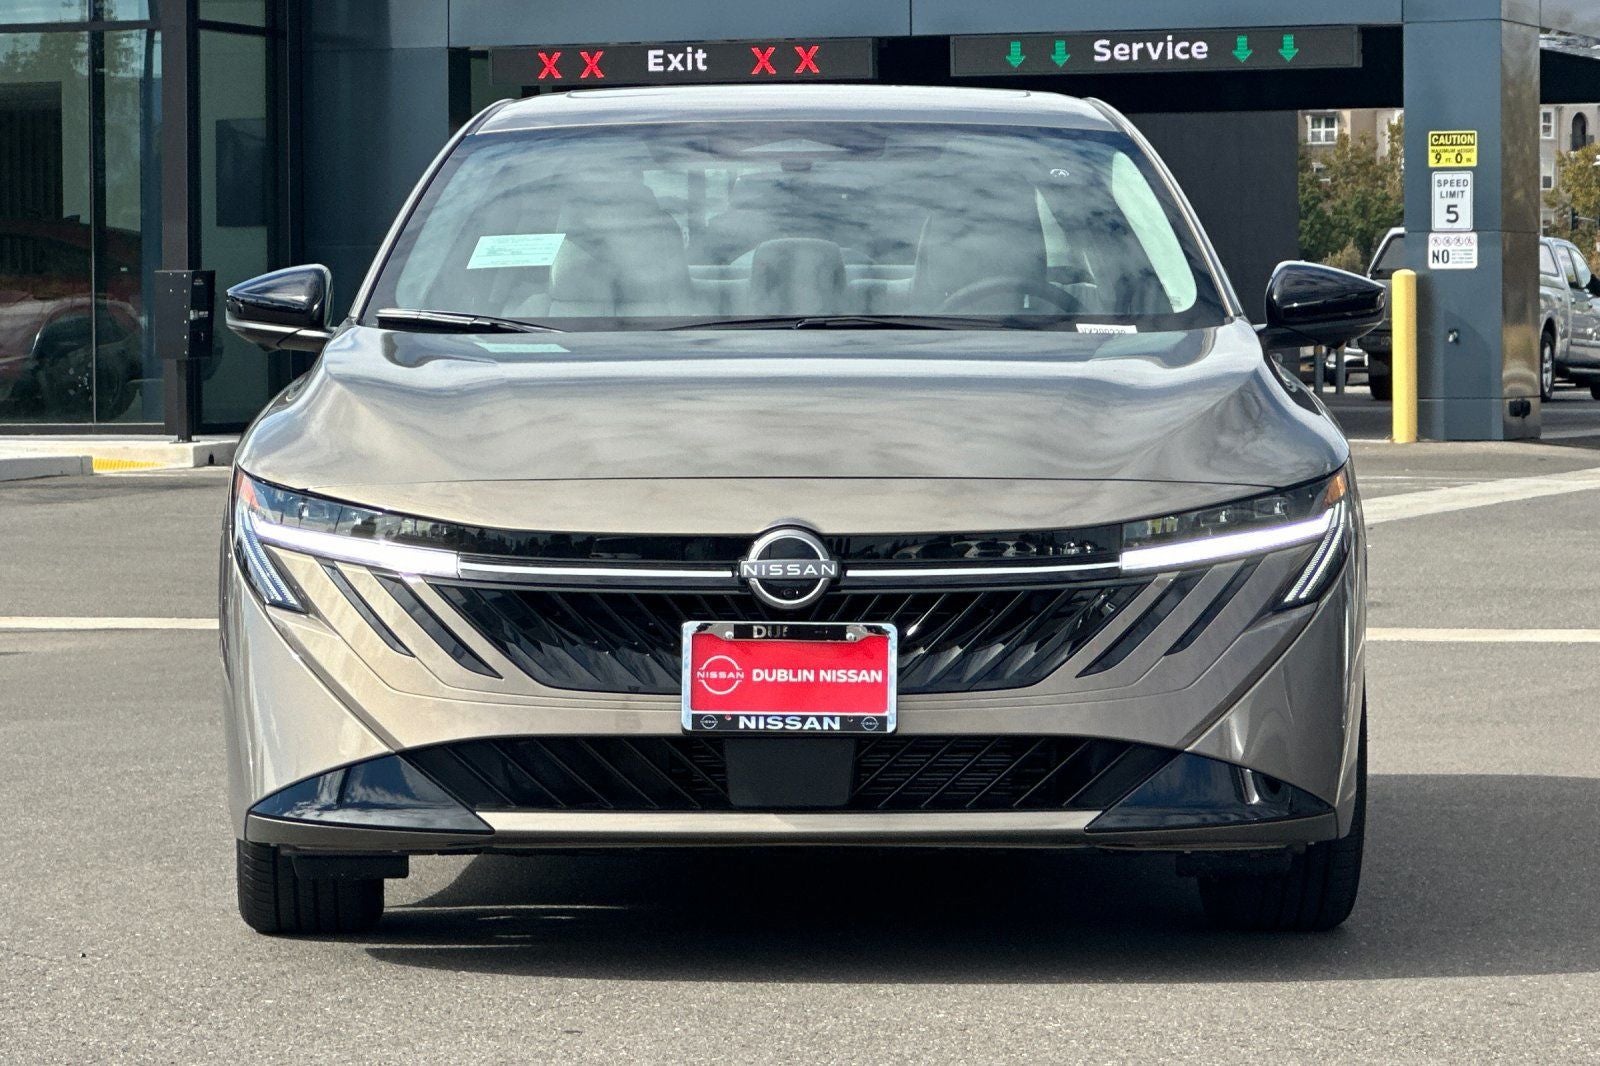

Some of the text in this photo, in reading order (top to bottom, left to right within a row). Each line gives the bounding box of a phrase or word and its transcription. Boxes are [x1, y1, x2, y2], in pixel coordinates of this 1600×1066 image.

[1093, 35, 1209, 62] Service
[647, 46, 708, 72] Exit
[1431, 134, 1475, 145] CAUTION
[1435, 152, 1442, 164] 9
[1455, 152, 1463, 164] 0
[1436, 178, 1469, 188] SPEED
[1440, 190, 1466, 199] LIMIT
[1446, 204, 1459, 223] 5
[1432, 249, 1450, 264] NO
[743, 563, 835, 576] NISSAN
[696, 671, 744, 679] NISSAN
[752, 669, 883, 683] DUBLIN NISSAN
[738, 715, 841, 730] NISSAN
